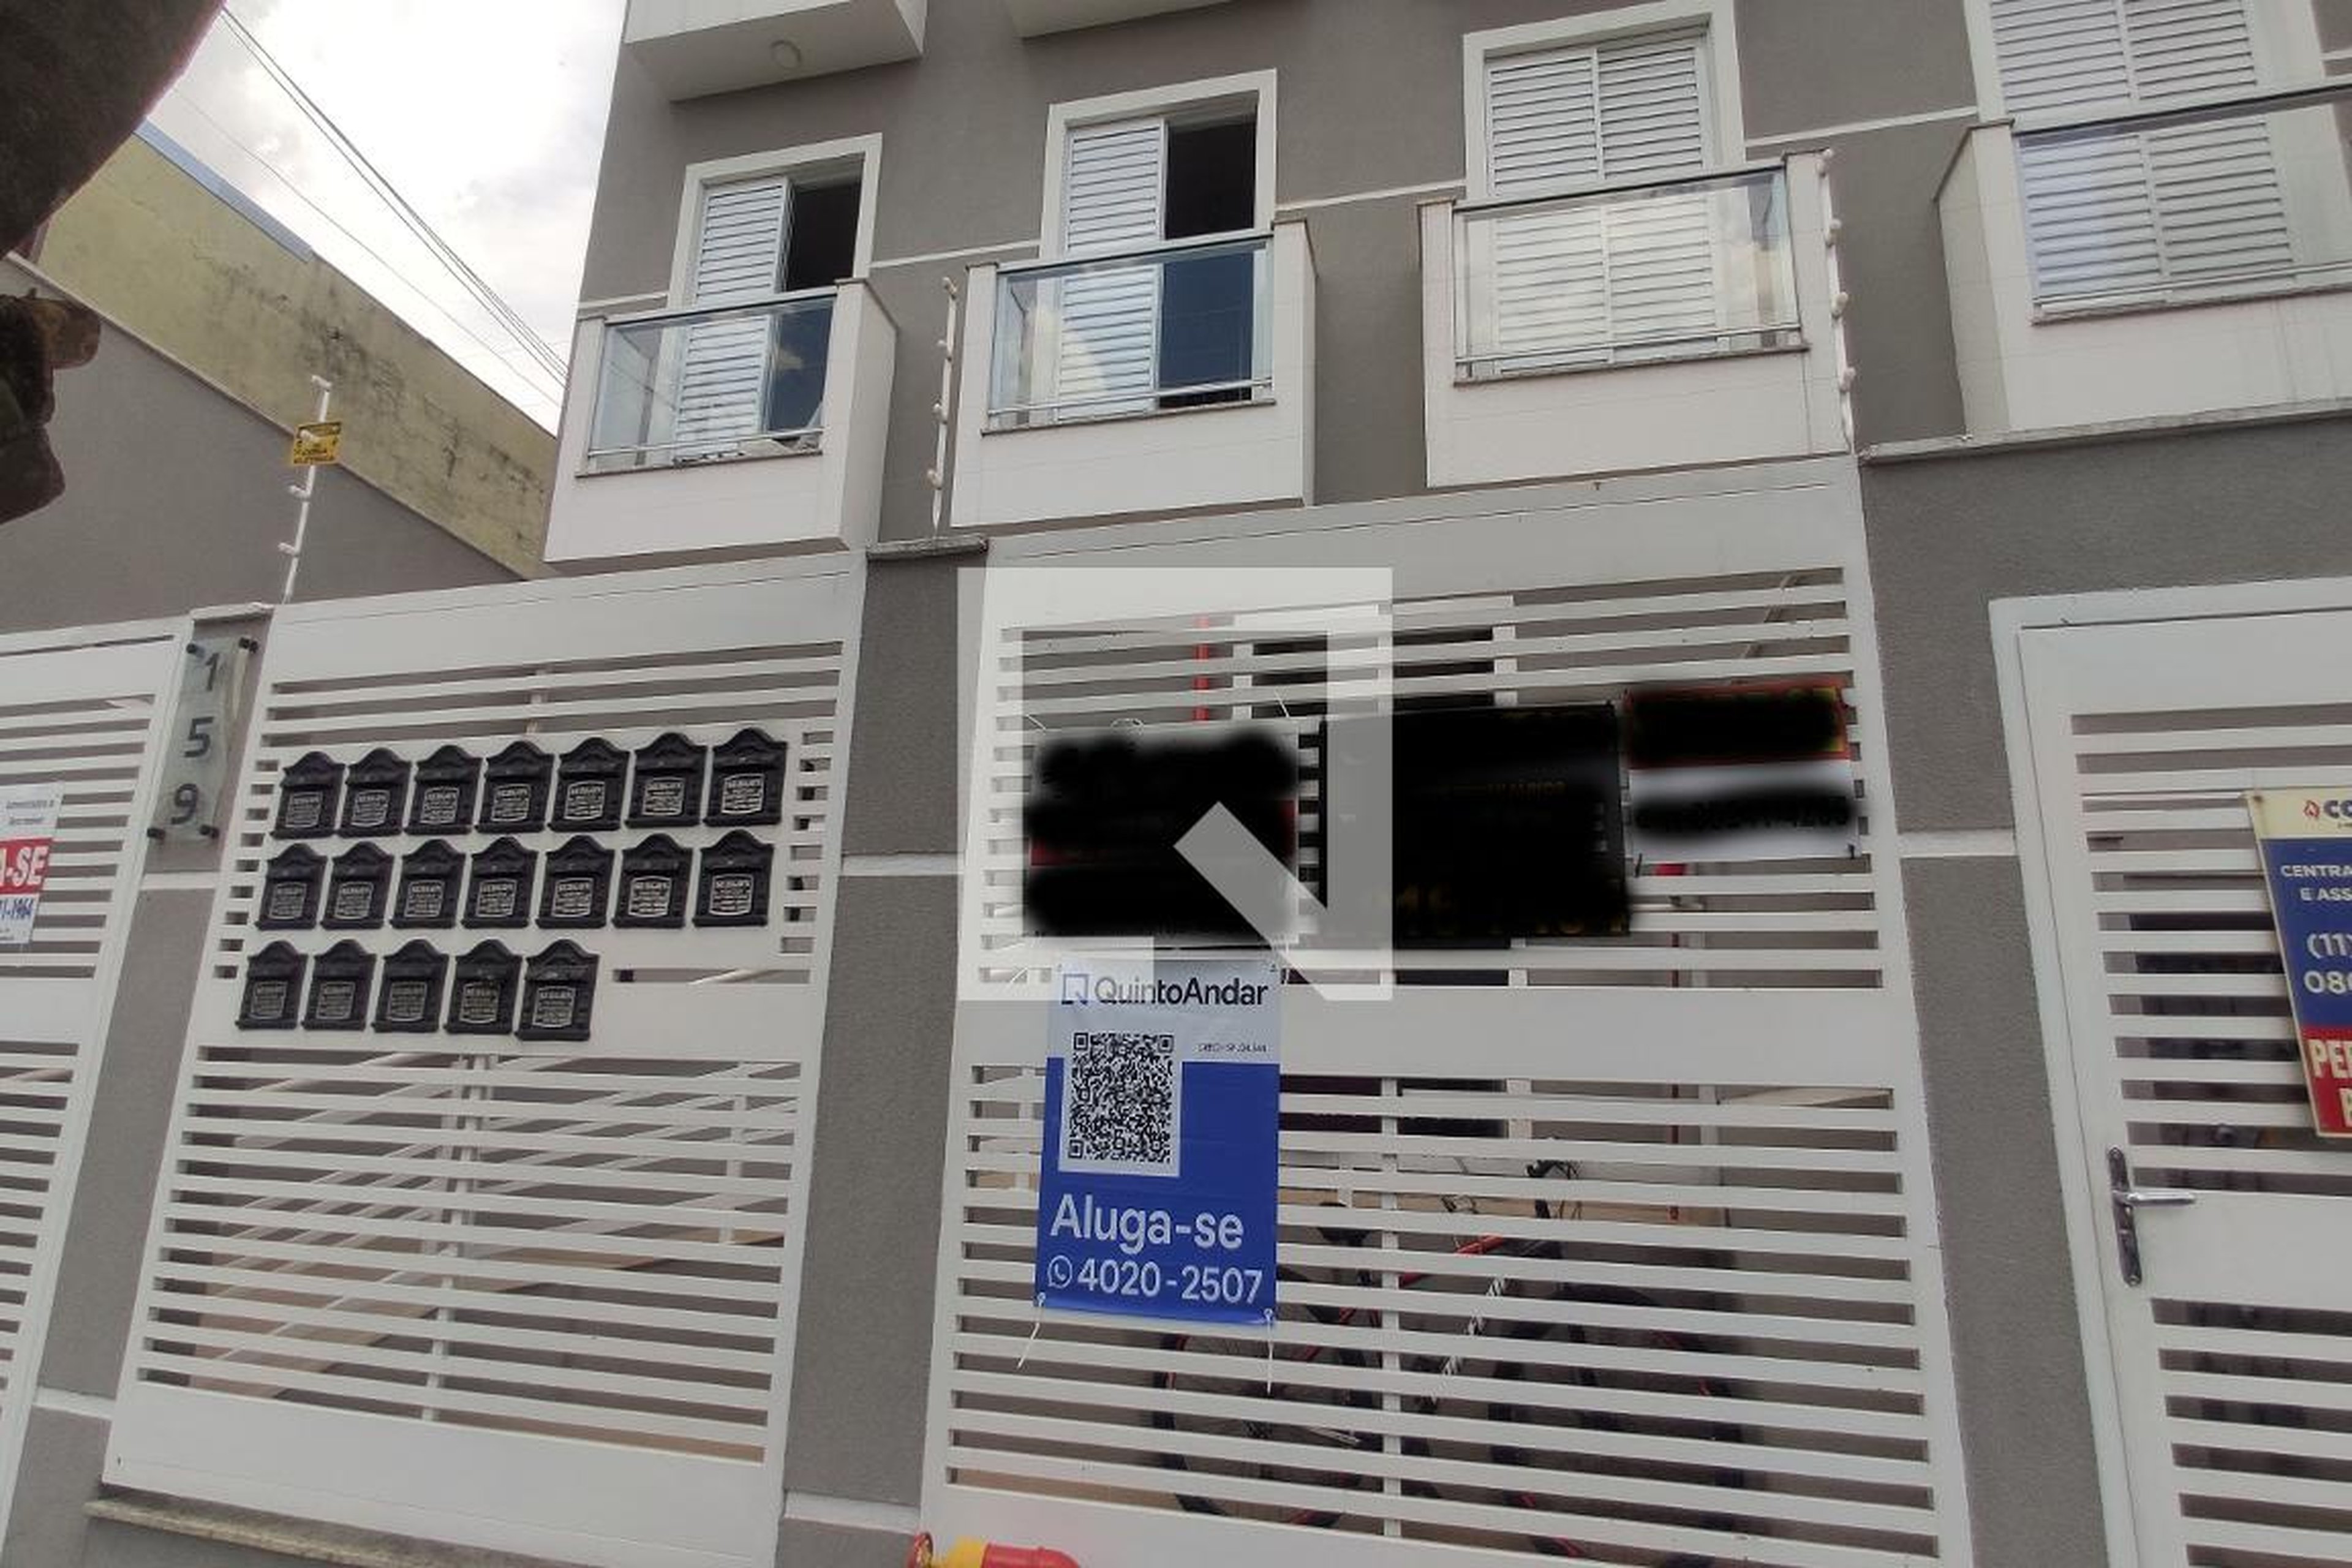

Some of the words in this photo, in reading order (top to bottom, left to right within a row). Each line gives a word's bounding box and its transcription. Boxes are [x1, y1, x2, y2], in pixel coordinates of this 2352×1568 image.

[1095, 977, 1268, 1005] QuintoAndar
[2304, 971, 2352, 994] 08
[1050, 1194, 1244, 1254] Aluga-se
